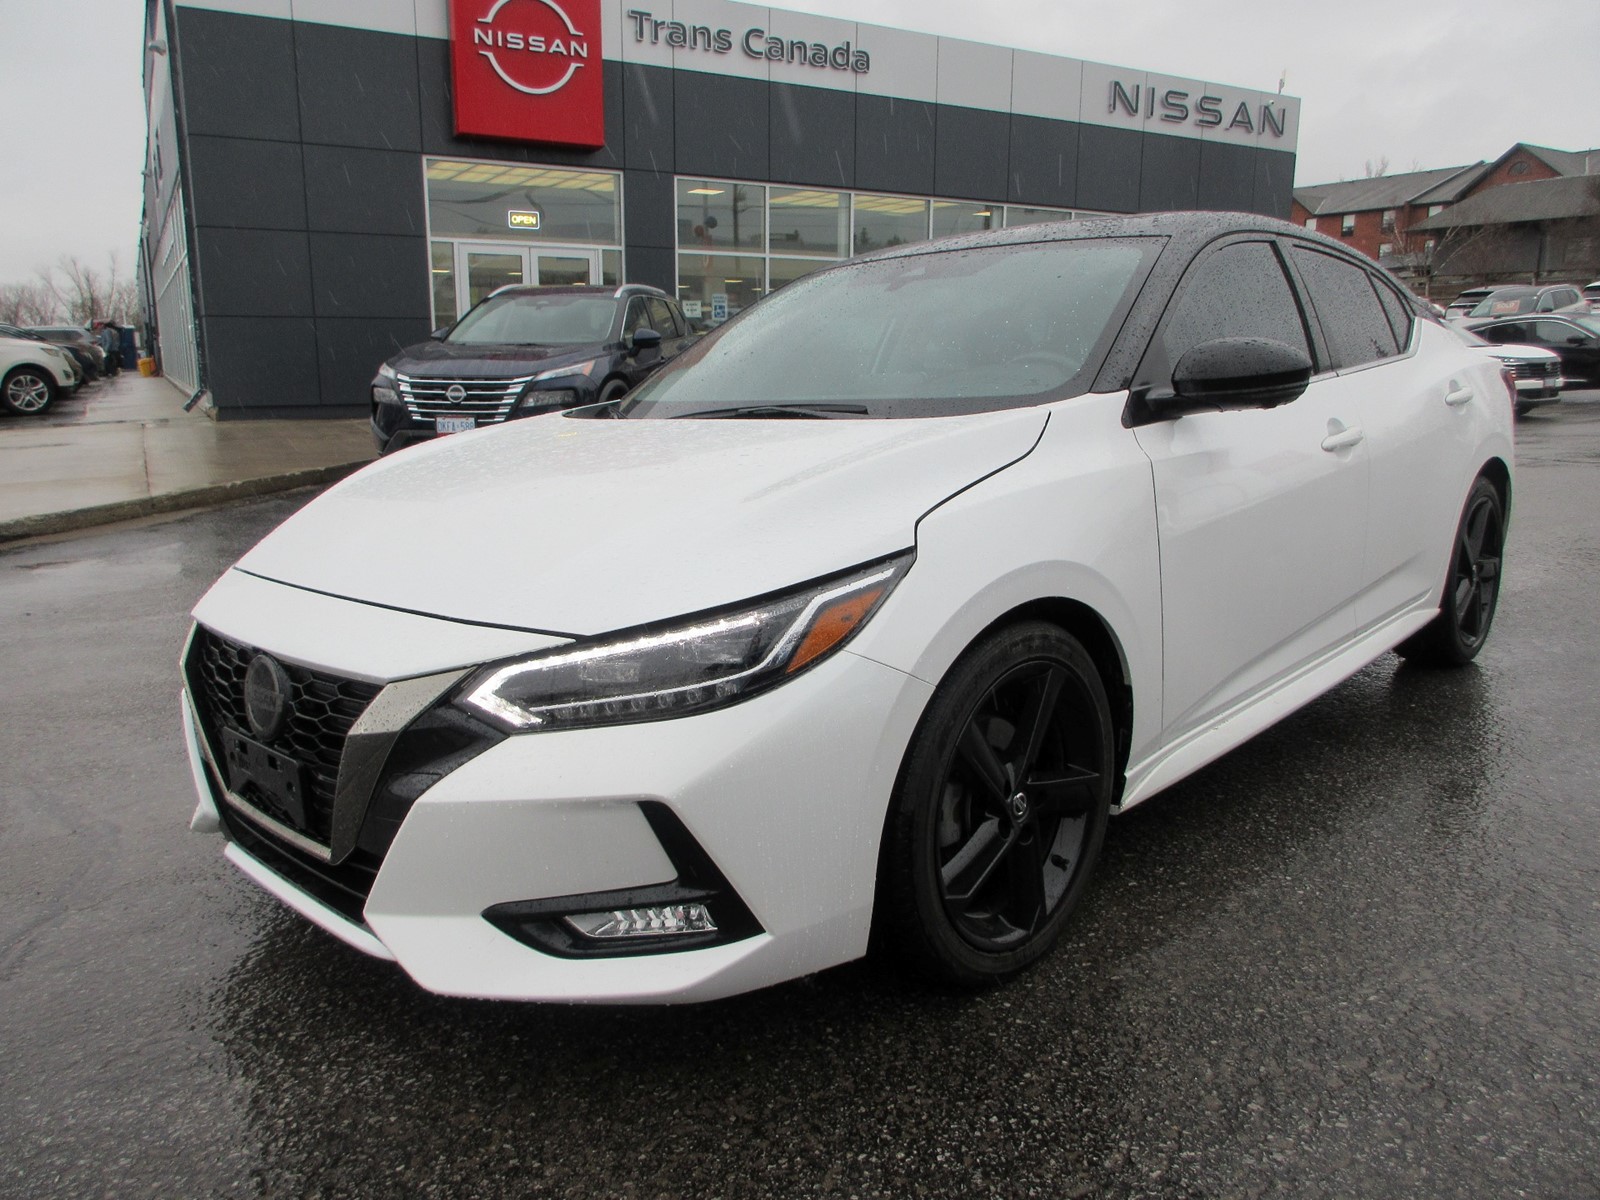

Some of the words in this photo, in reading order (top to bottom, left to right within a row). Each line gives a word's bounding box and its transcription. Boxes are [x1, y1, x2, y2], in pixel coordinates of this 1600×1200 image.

[474, 27, 588, 58] NISSAN
[627, 9, 733, 54] Trans
[743, 27, 871, 73] Canada
[1108, 80, 1286, 137] NISSAN
[511, 215, 537, 225] OPEN
